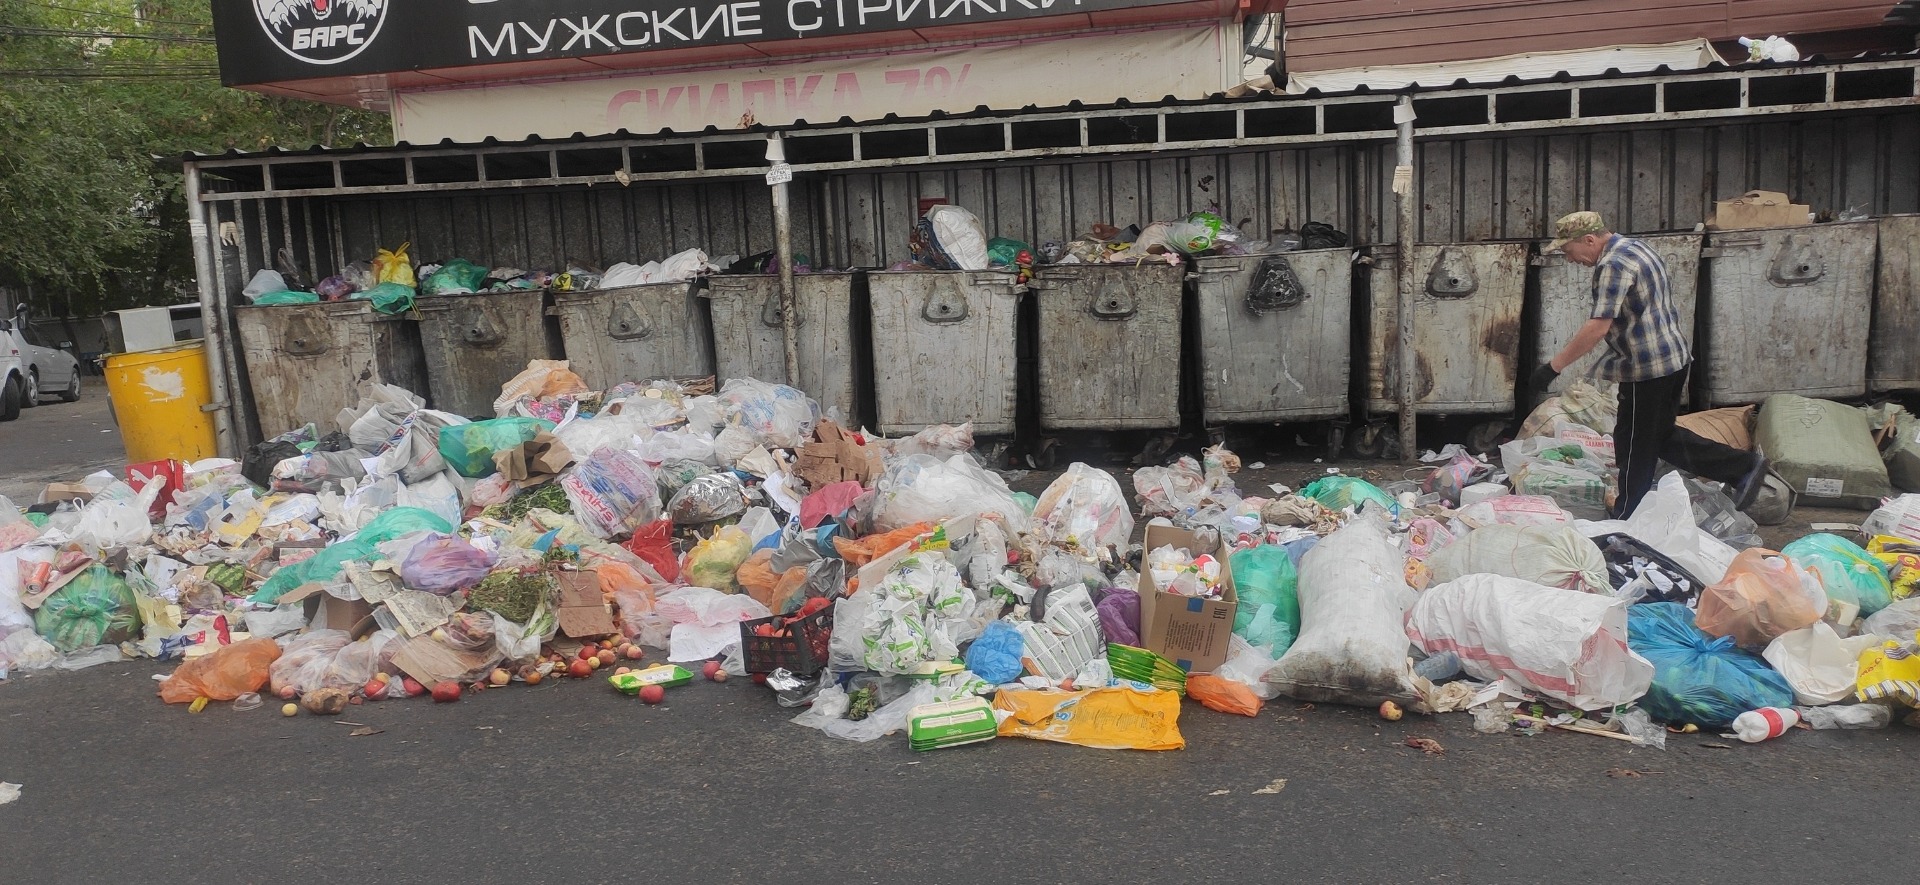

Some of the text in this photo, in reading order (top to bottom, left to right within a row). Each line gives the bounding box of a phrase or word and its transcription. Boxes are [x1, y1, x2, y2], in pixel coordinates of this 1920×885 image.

[292, 22, 366, 51] БАРС
[467, 0, 1081, 58] МУЖСКИЕ СТРИ
